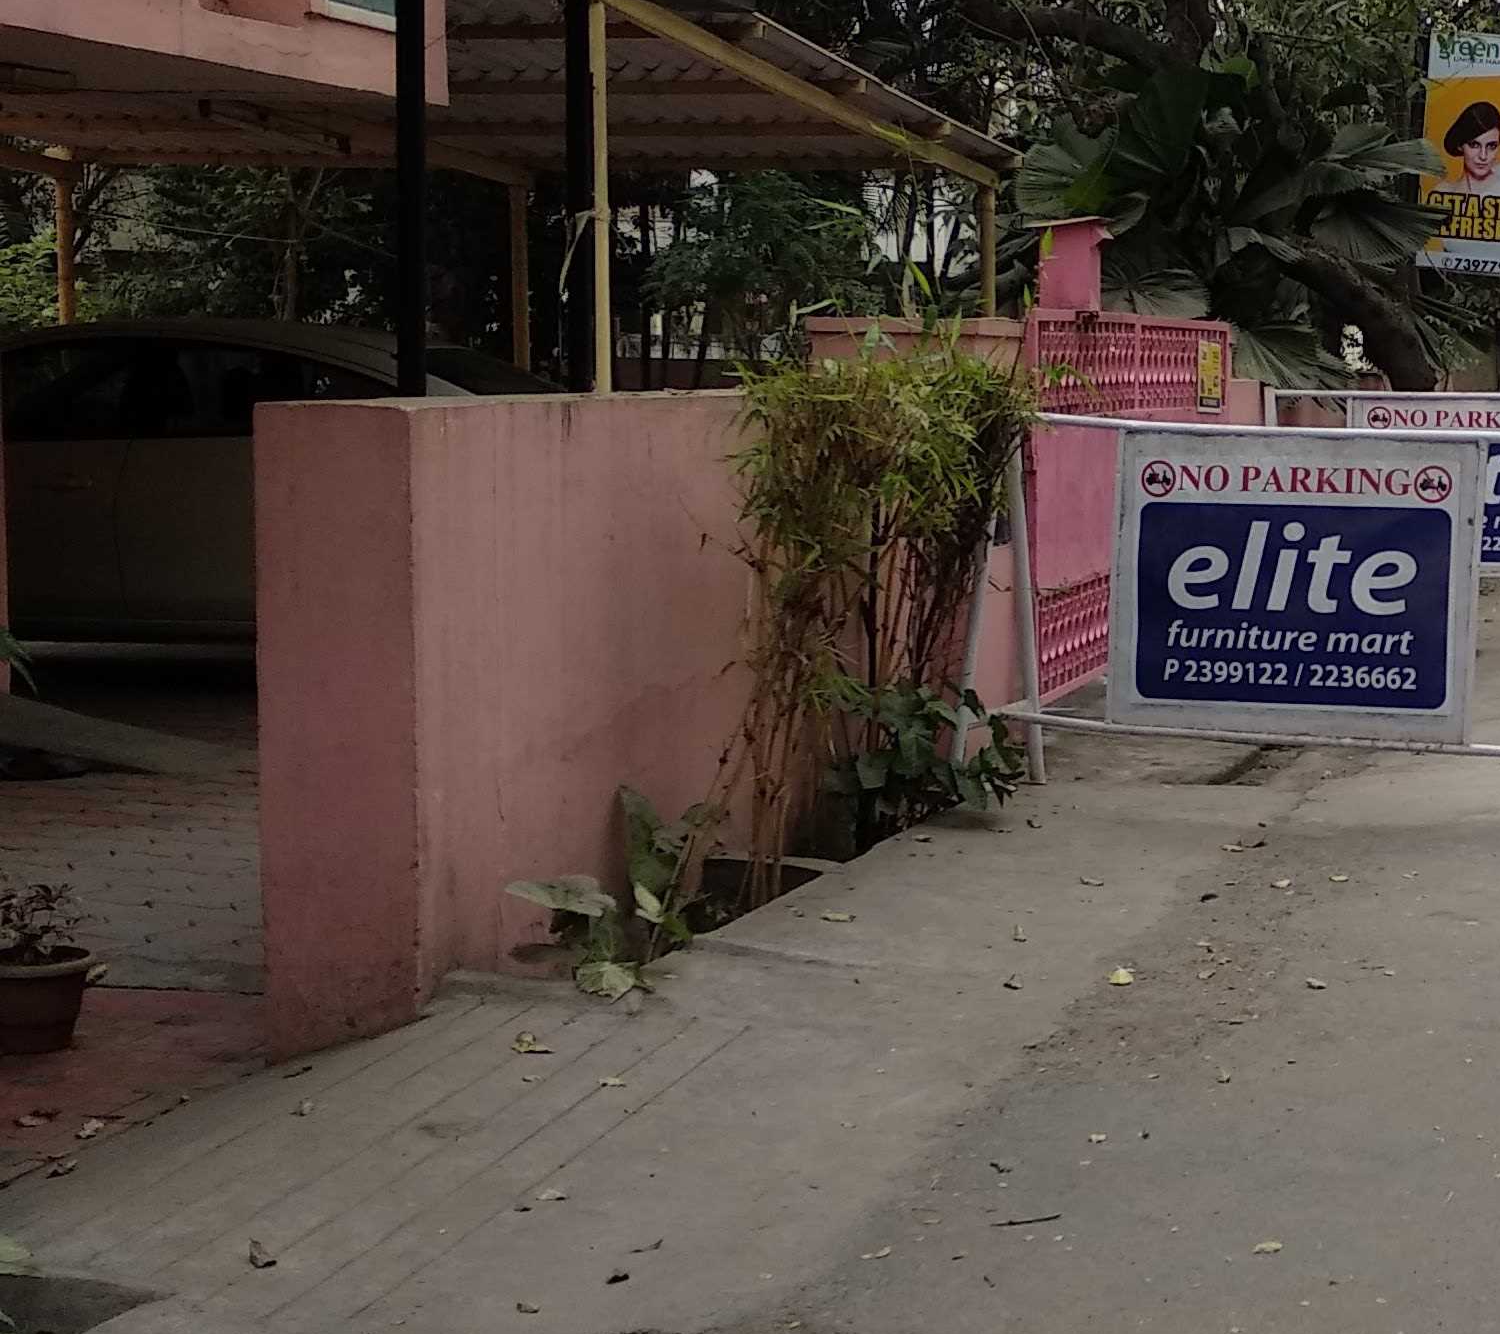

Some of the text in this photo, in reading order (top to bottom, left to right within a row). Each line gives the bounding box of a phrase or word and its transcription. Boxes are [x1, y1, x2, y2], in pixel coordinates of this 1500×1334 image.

[1438, 38, 1500, 60] green
[1466, 196, 1480, 219] A
[1393, 408, 1428, 428] NO
[1177, 464, 1412, 497] NO PARKING
[1167, 520, 1418, 616] elite
[1166, 619, 1415, 656] furniture mart
[1163, 658, 1418, 691] P 2399122 / 2236662
